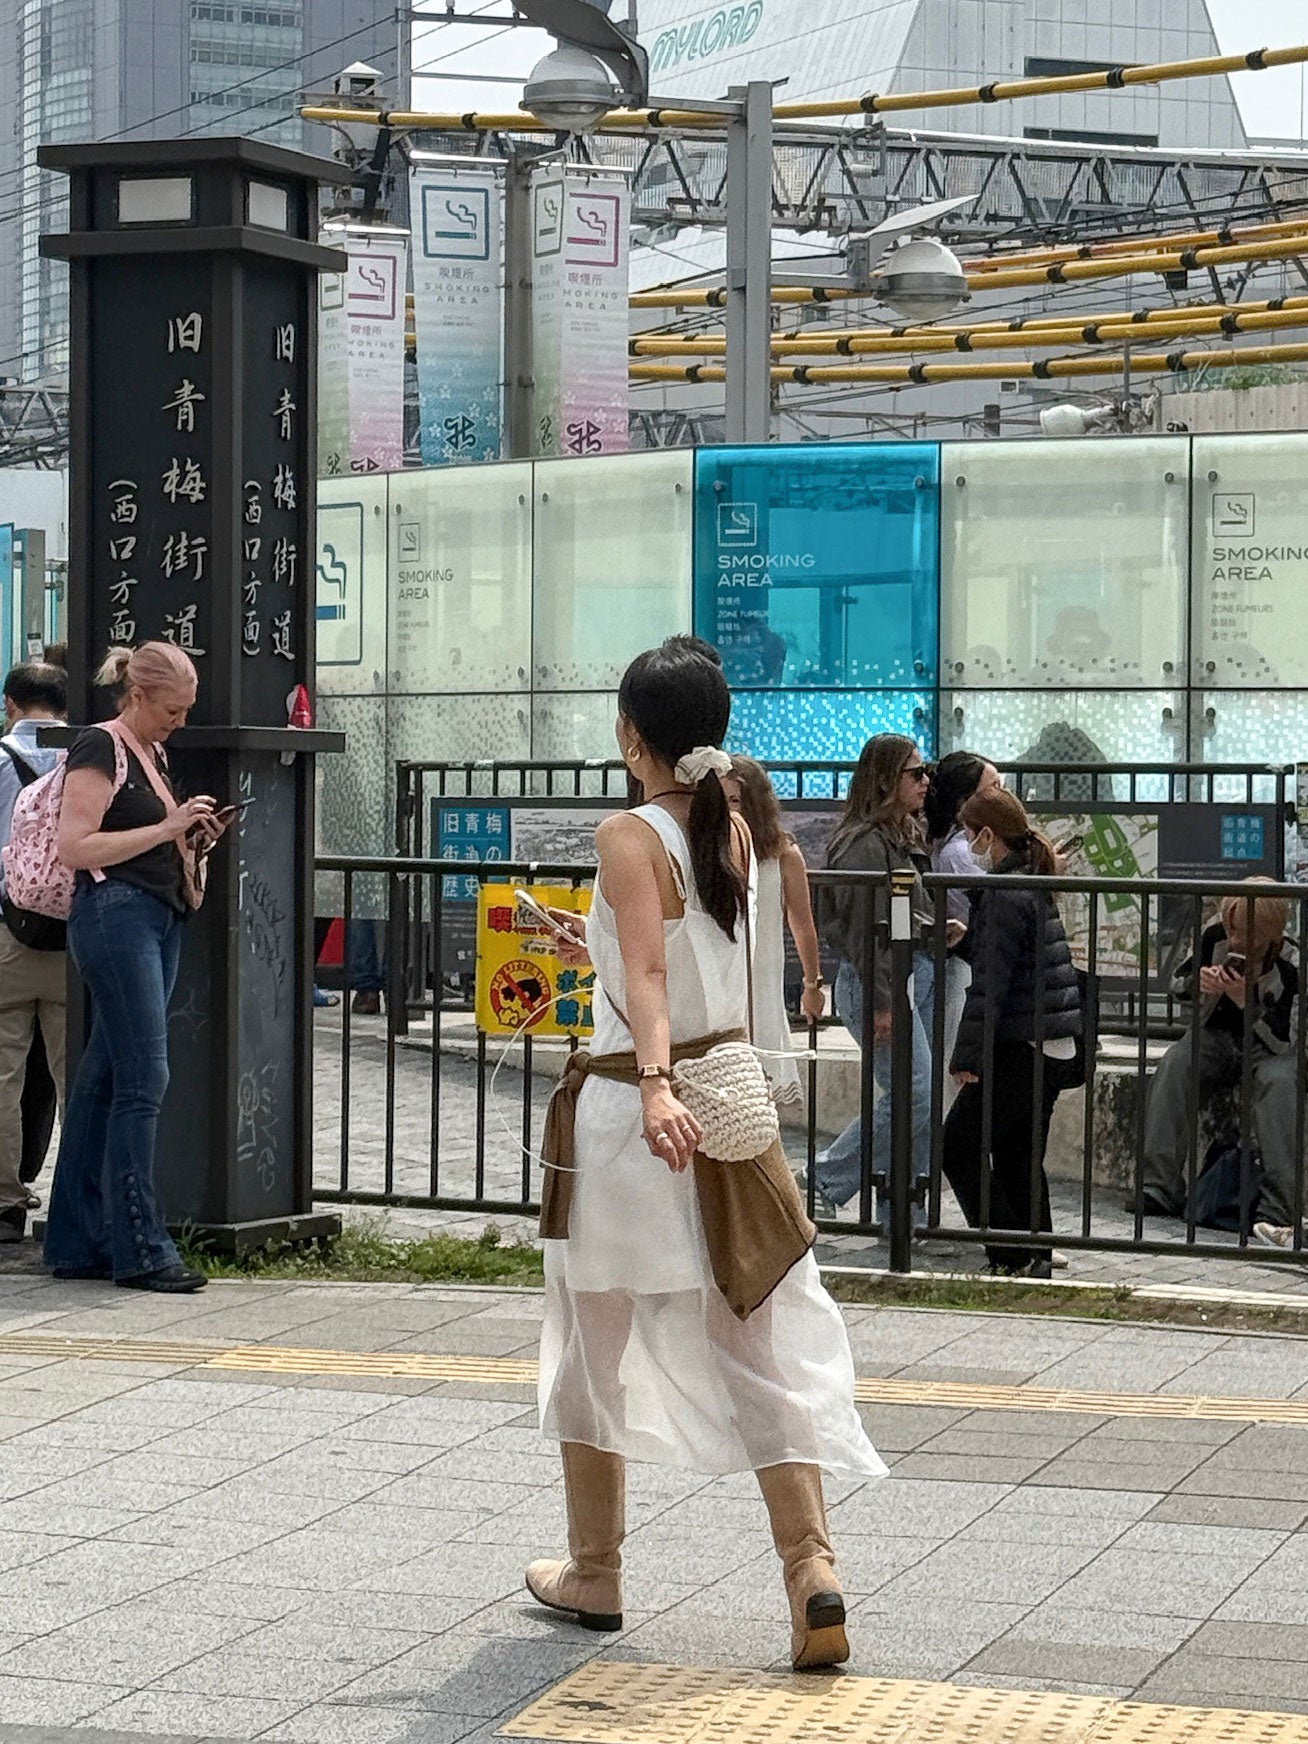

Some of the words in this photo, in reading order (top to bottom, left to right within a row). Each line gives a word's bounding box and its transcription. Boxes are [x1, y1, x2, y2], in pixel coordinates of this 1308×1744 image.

[650, 1, 763, 73] MYLORD
[562, 289, 618, 300] MOKING
[160, 311, 208, 657] 旧青梅街道
[272, 323, 297, 661] 旧青梅街道
[717, 553, 816, 569] SMOKING
[398, 568, 454, 584] SMOKING
[717, 573, 773, 587] AREA
[1211, 566, 1273, 581] AREA
[398, 587, 430, 600] AREA
[443, 812, 503, 834] 旧青梅
